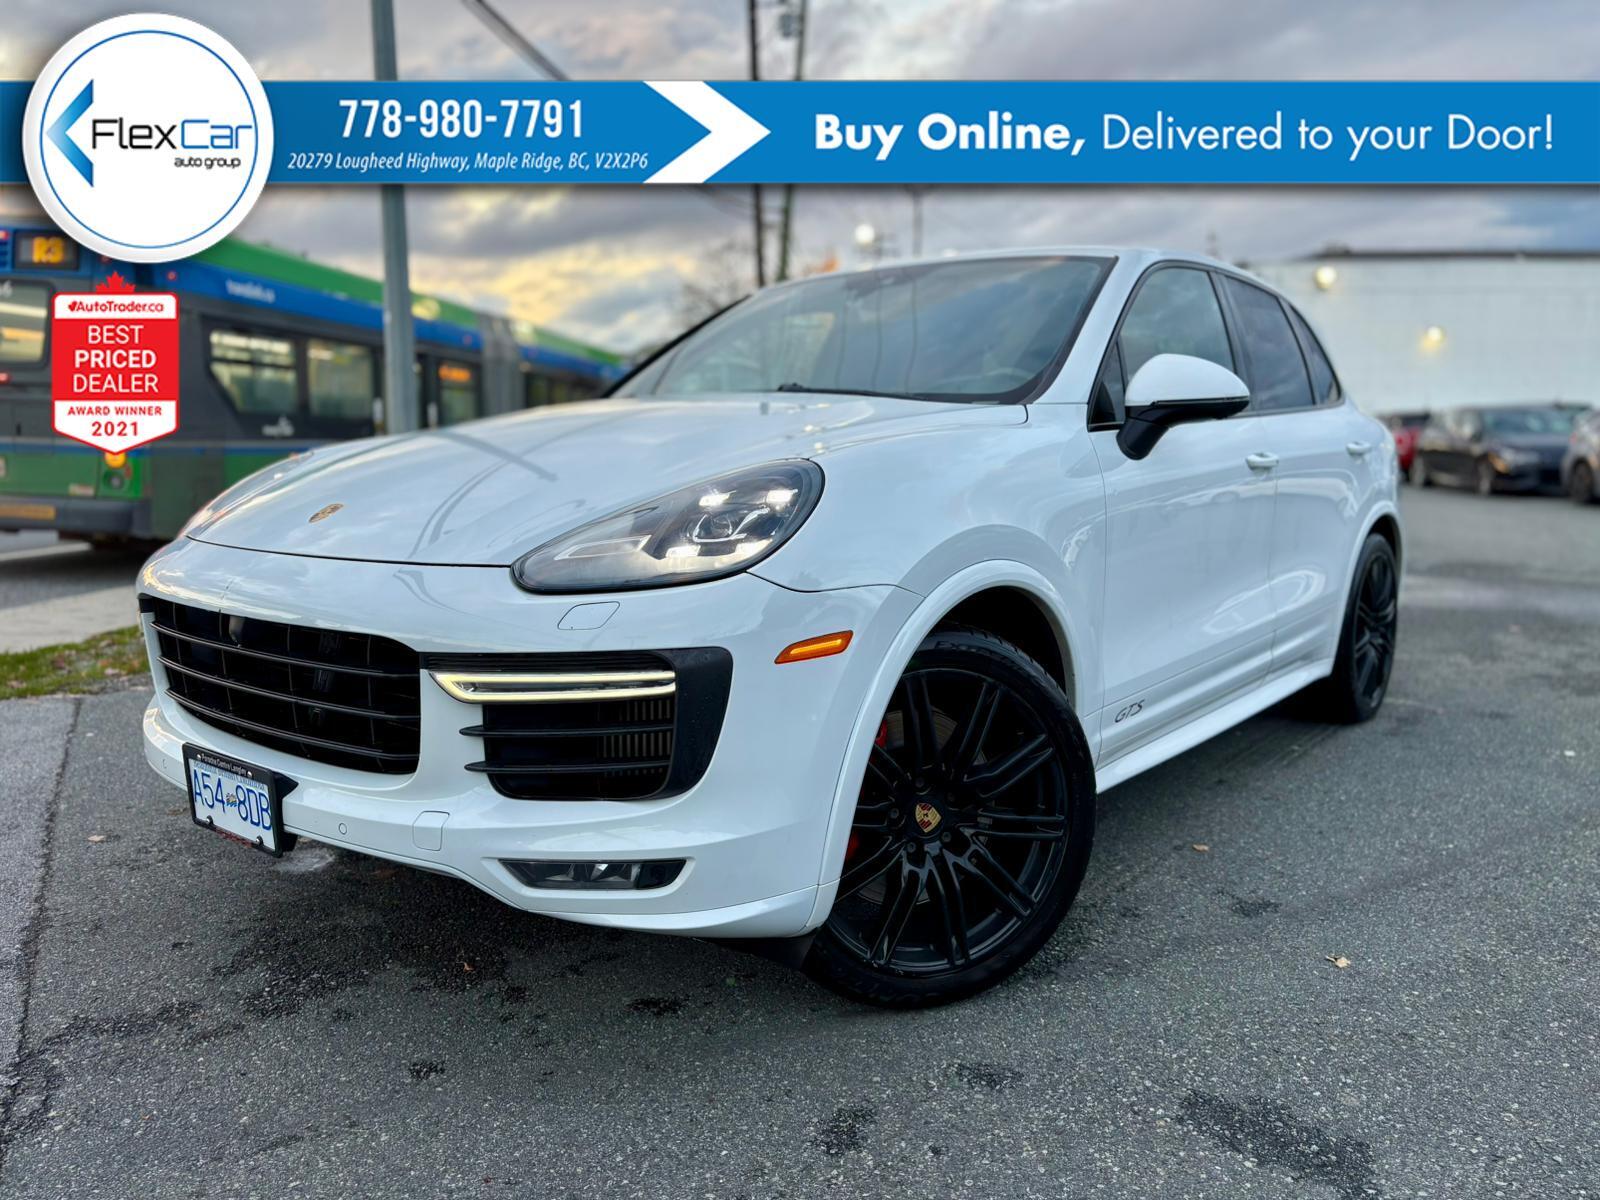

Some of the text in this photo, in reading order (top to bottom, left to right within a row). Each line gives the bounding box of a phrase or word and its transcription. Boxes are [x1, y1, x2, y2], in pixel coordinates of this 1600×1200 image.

[1114, 699, 1146, 724] GTS
[193, 769, 226, 814] A54
[236, 784, 272, 831] 8DB
